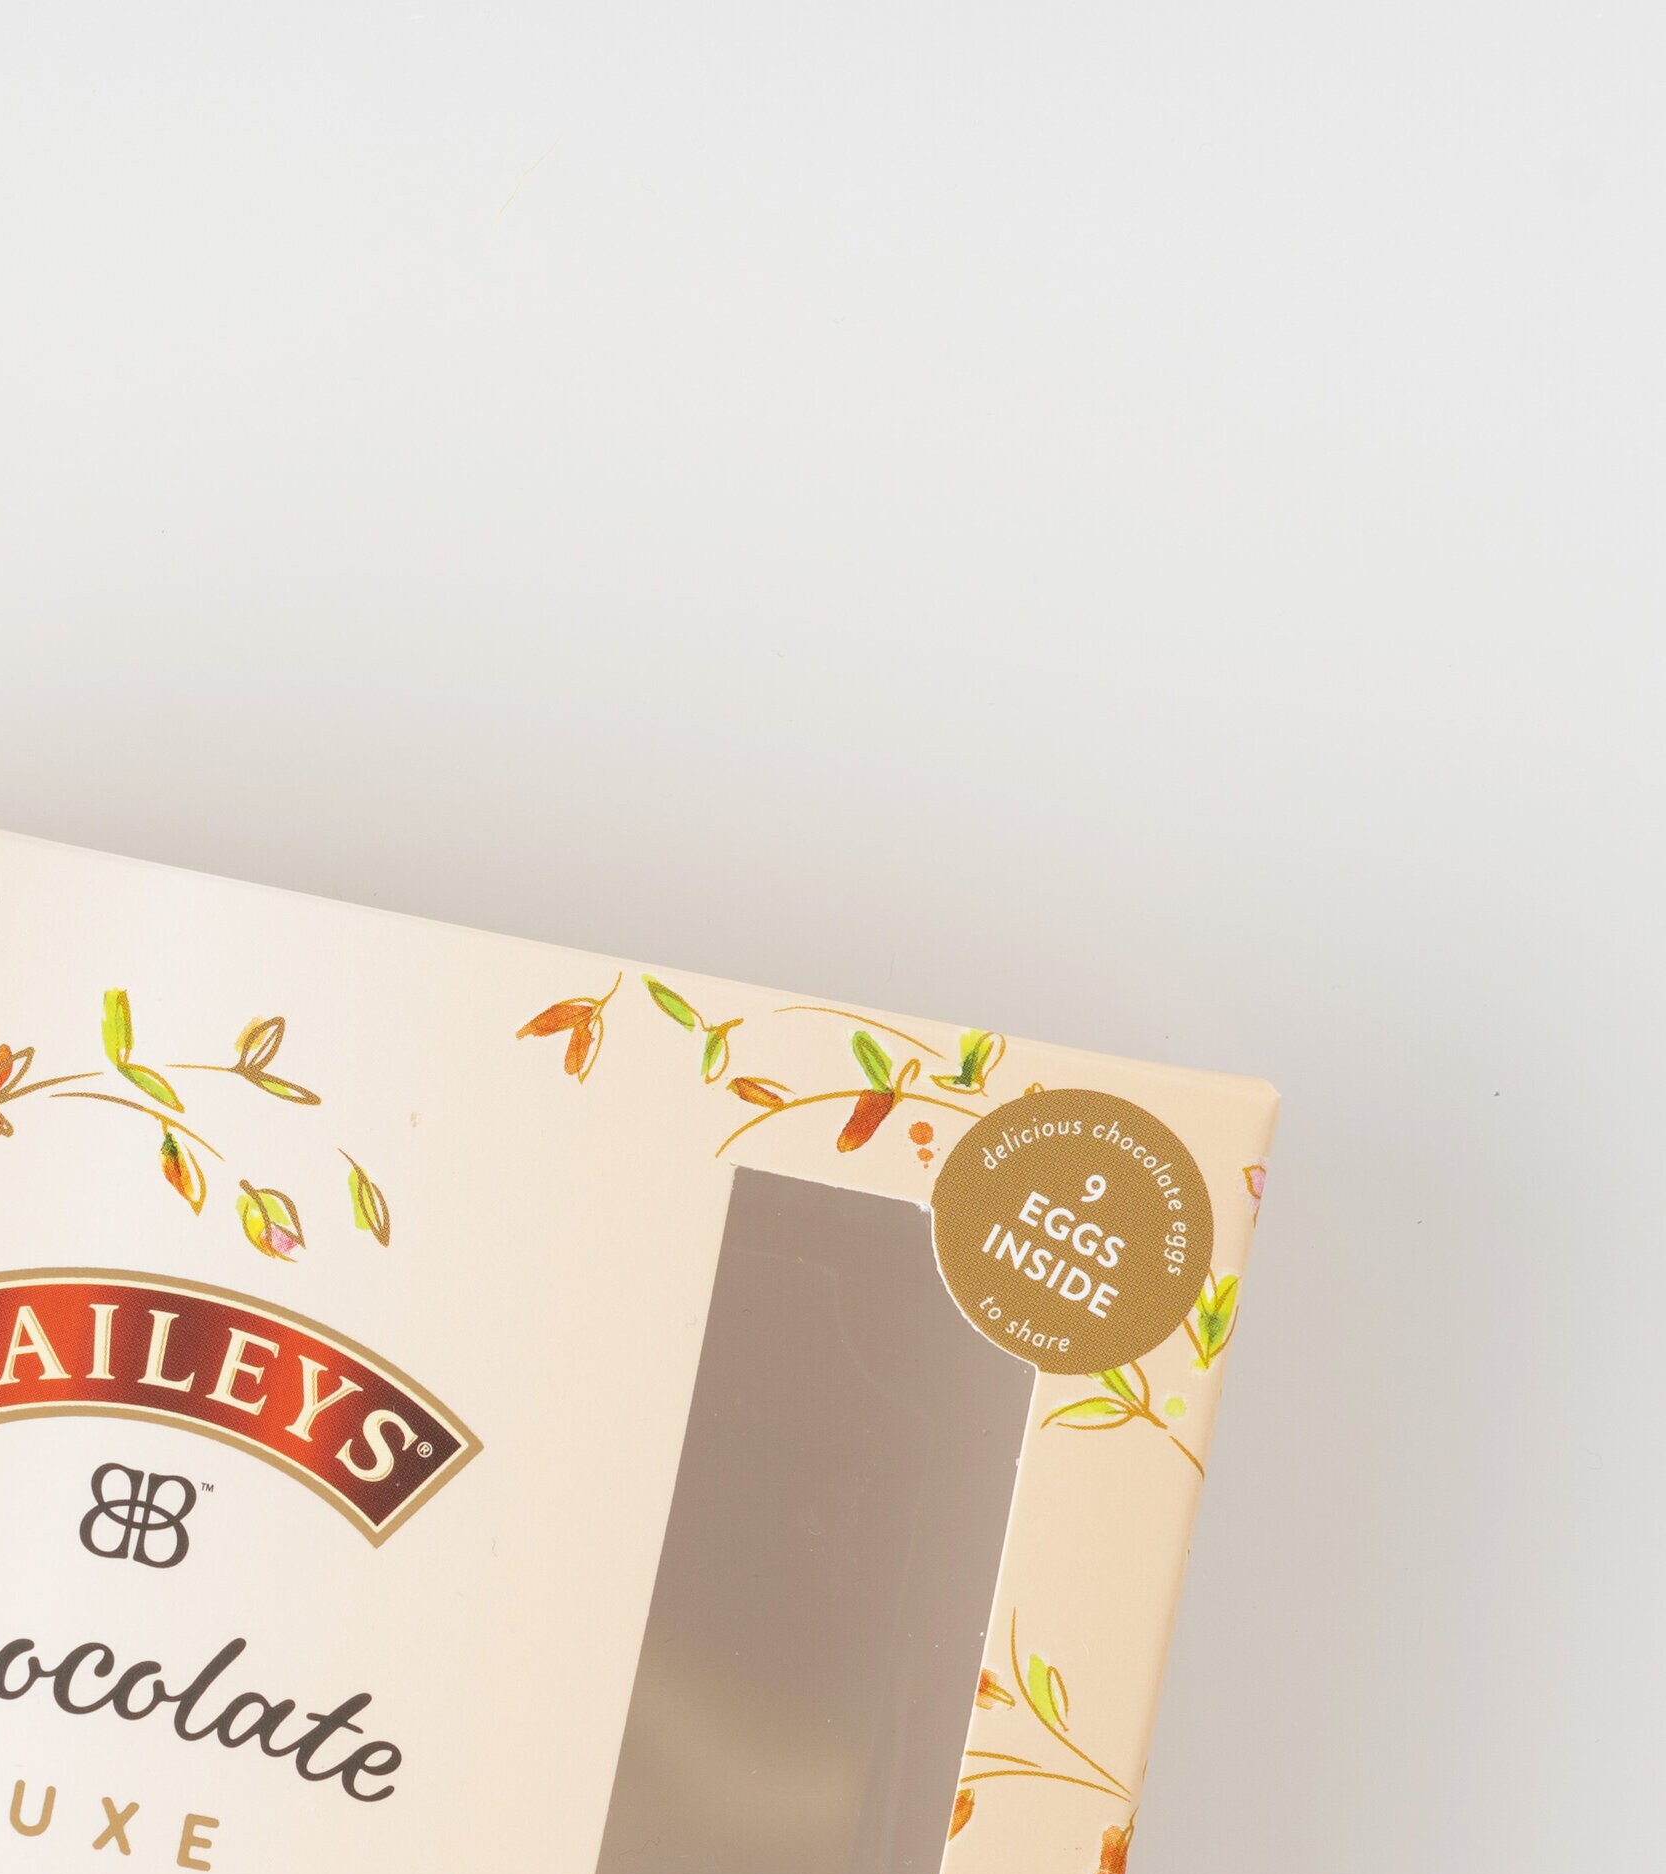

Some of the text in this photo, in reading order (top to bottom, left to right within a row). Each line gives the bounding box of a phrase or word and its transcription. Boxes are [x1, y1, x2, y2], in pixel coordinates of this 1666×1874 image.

[982, 1118, 1186, 1275] delicious chocolate eggs
[1081, 1175, 1106, 1202] 9
[1019, 1192, 1125, 1267] EGGS
[983, 1224, 1118, 1318] INSIDE
[979, 1295, 1069, 1351] to share
